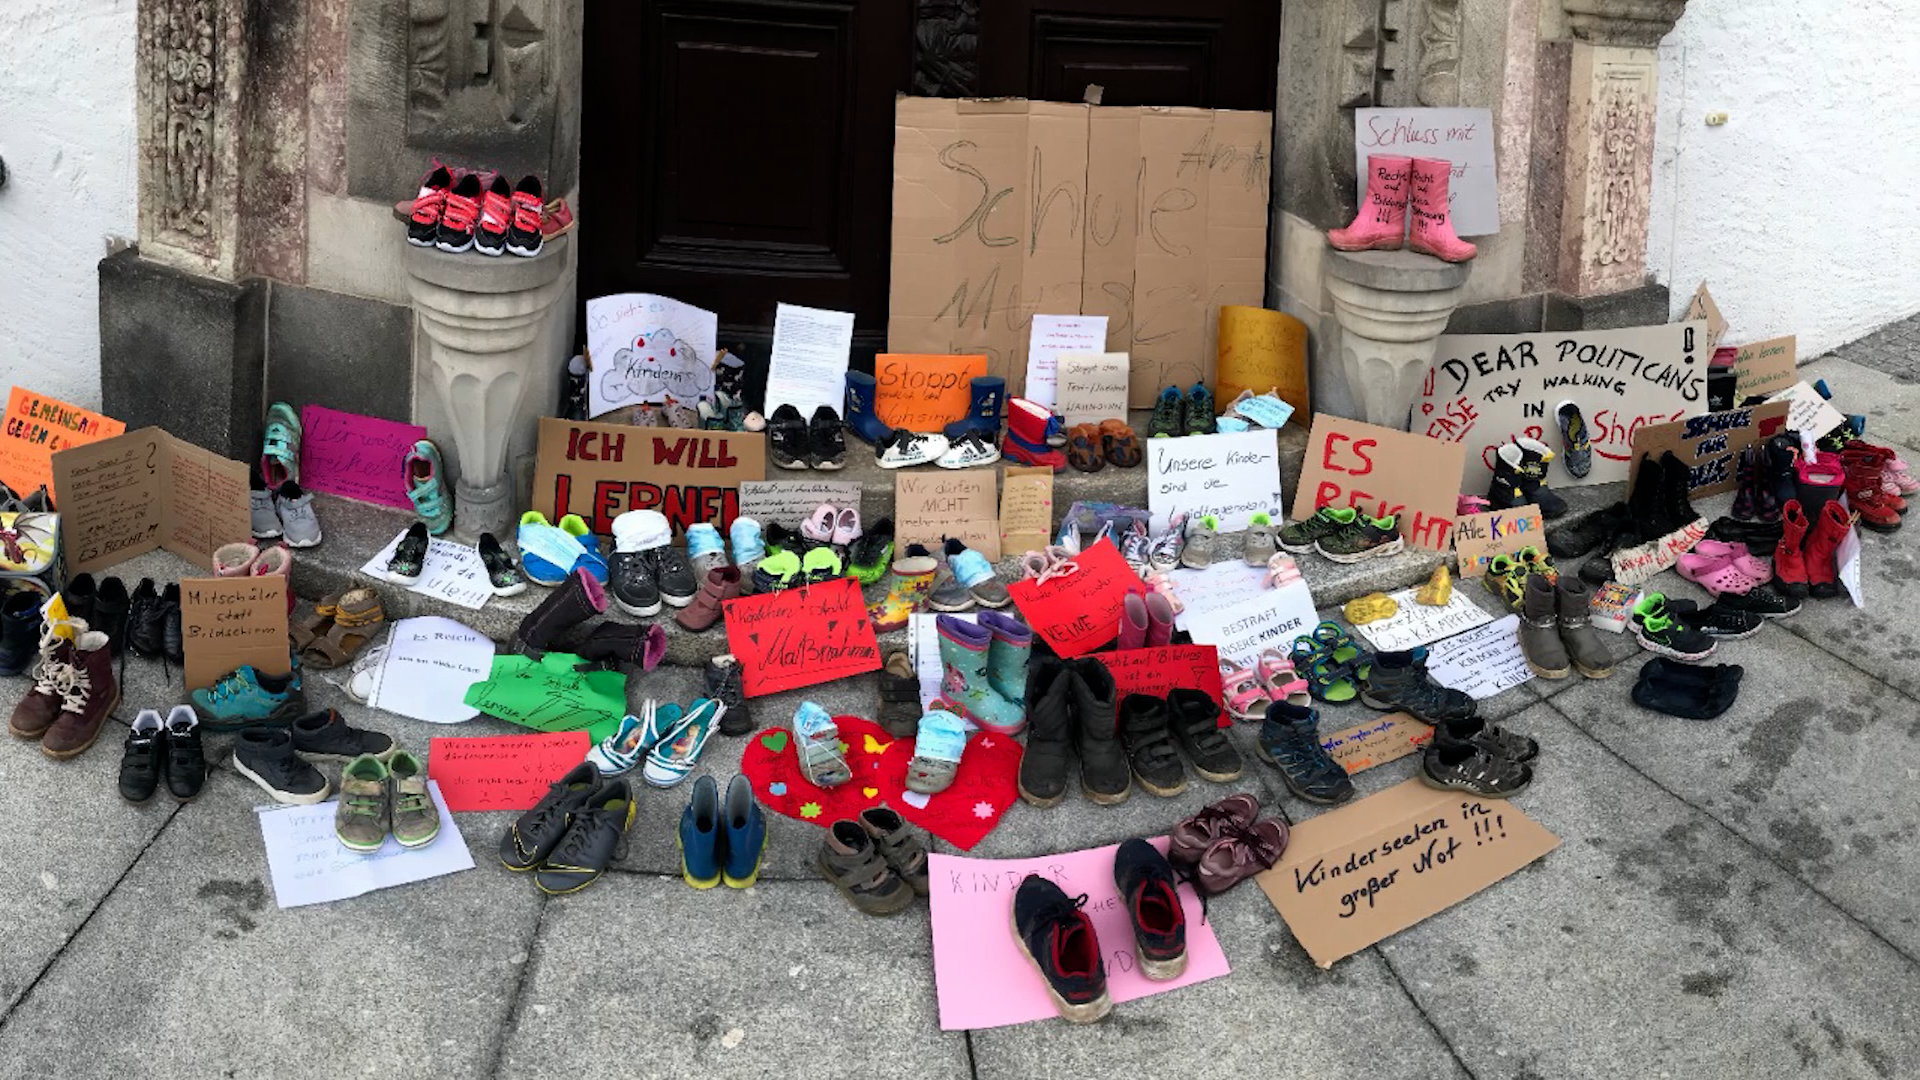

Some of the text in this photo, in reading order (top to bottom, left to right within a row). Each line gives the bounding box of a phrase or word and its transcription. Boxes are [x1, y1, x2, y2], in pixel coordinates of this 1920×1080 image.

[1360, 114, 1475, 147] Schluss mit
[931, 139, 1198, 258] Schule
[879, 363, 971, 391] Stoppt
[1441, 341, 1539, 395] DEAR
[1483, 372, 1627, 403] TRY WALKING
[18, 396, 99, 437] GEMEINSAM
[1523, 400, 1545, 418] IN
[7, 417, 48, 445] GEGEN
[567, 428, 738, 468] ICH WILL
[1158, 447, 1218, 475] Unsere
[1322, 432, 1378, 476] ES
[900, 477, 981, 495] Wir dürfen
[1160, 479, 1229, 494] sind die
[1490, 514, 1543, 541] KINDER
[1043, 614, 1097, 644] KEINE
[1221, 606, 1278, 637] BESTRAFT
[1219, 635, 1258, 658] NSERE
[1258, 617, 1302, 642] KINDER
[1294, 802, 1493, 894] Kinderseelen in
[950, 864, 1069, 893] KINDR
[1338, 815, 1507, 918] großer Not !!!
